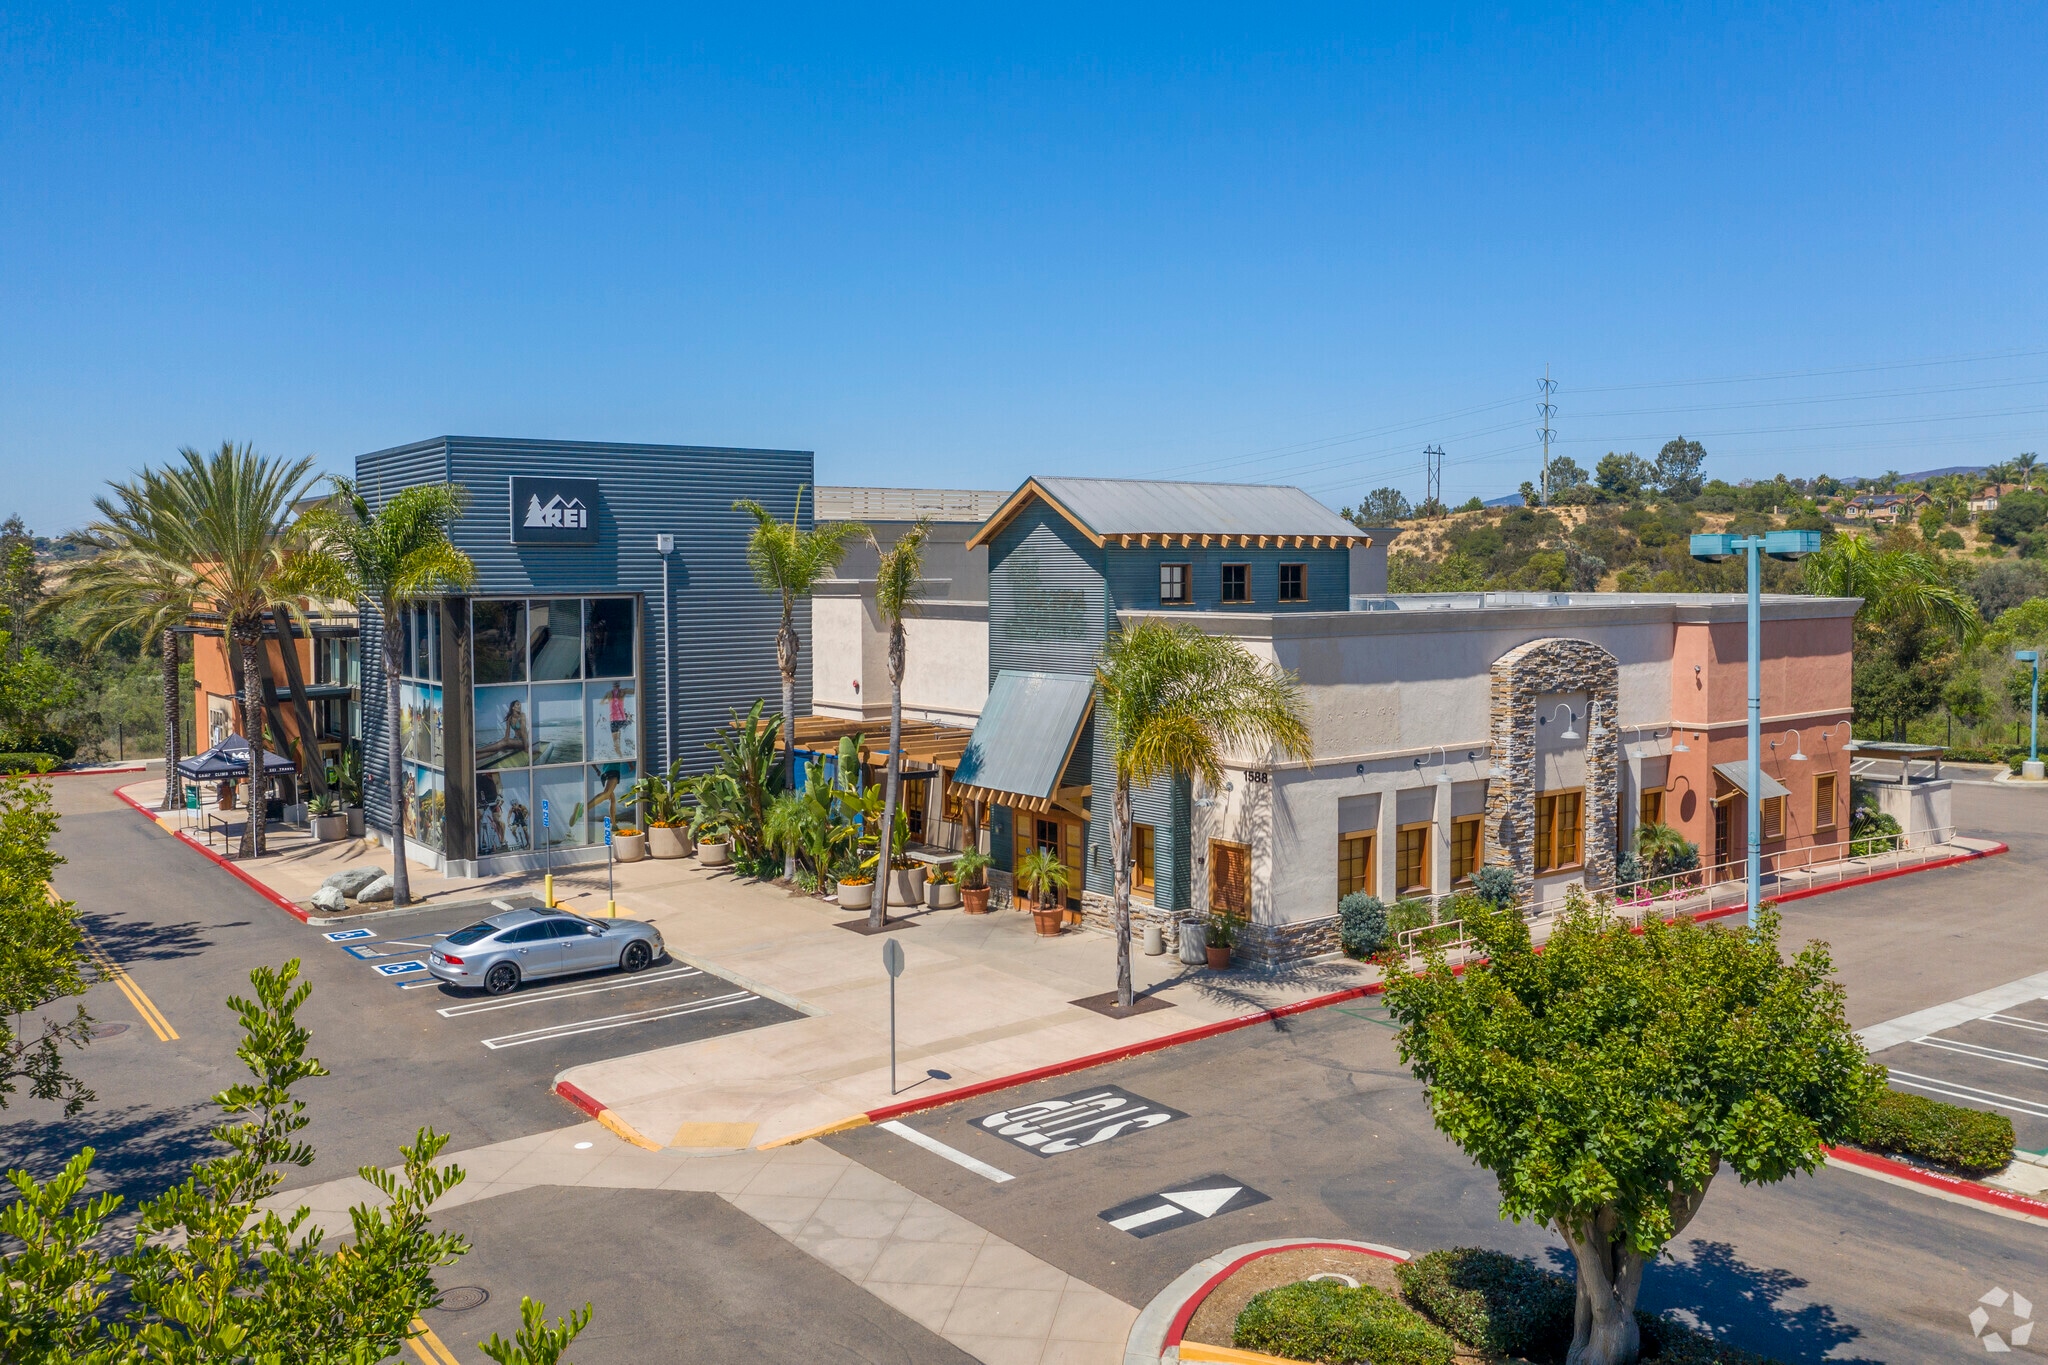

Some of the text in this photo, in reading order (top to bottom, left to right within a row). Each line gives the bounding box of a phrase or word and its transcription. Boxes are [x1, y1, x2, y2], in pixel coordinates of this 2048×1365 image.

[545, 508, 587, 528] REI
[1243, 770, 1268, 784] 1588
[982, 1092, 1172, 1153] STOP
[1924, 1171, 1961, 1185] PARKING
[1988, 1189, 2015, 1200] FIRE
[2020, 1197, 2048, 1209] LANE
